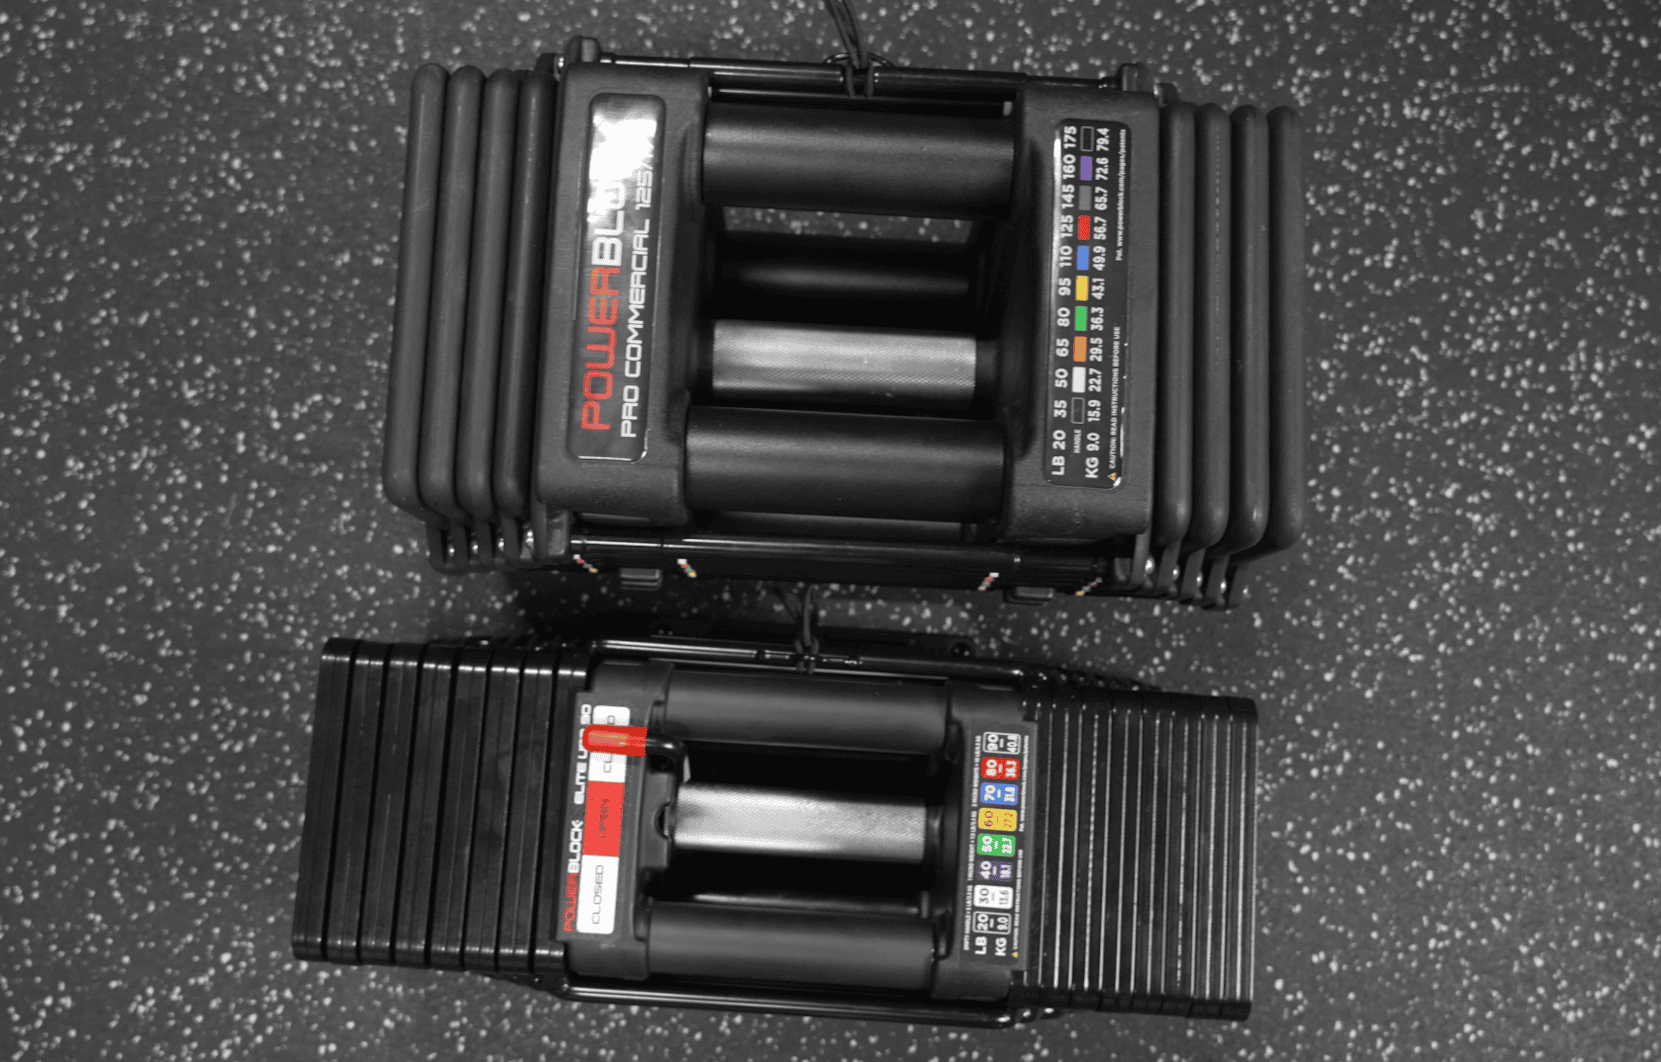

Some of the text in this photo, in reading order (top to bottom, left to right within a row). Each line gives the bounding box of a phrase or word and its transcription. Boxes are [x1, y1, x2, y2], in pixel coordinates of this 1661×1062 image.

[580, 113, 629, 430] POWERBLO
[624, 219, 650, 377] COMMERCIAL
[1051, 126, 1077, 475] LB 20 35 50 65 80 95 110 125 145 160 175
[1085, 128, 1109, 478] KG 9.0 15.9 22.7 29.5 36.3 43.1 49.9 56.7 65.7 72.6 79.4
[1112, 341, 1120, 367] BEFORE
[620, 385, 639, 437] PRO
[1110, 368, 1118, 416] INSTRUCTIONS
[1073, 429, 1081, 453] HANDLE
[1109, 437, 1117, 469] CAUTION:
[604, 715, 615, 773] CLD
[1006, 735, 1017, 753] 40.8
[563, 820, 583, 932] POWERBLOCK
[574, 762, 587, 804] ELITE
[974, 734, 999, 955] LB 20 30 40 50 60 70 80 90
[591, 865, 604, 924] CLOSED
[994, 937, 1007, 956] KG
[997, 917, 1008, 930] 9.0
